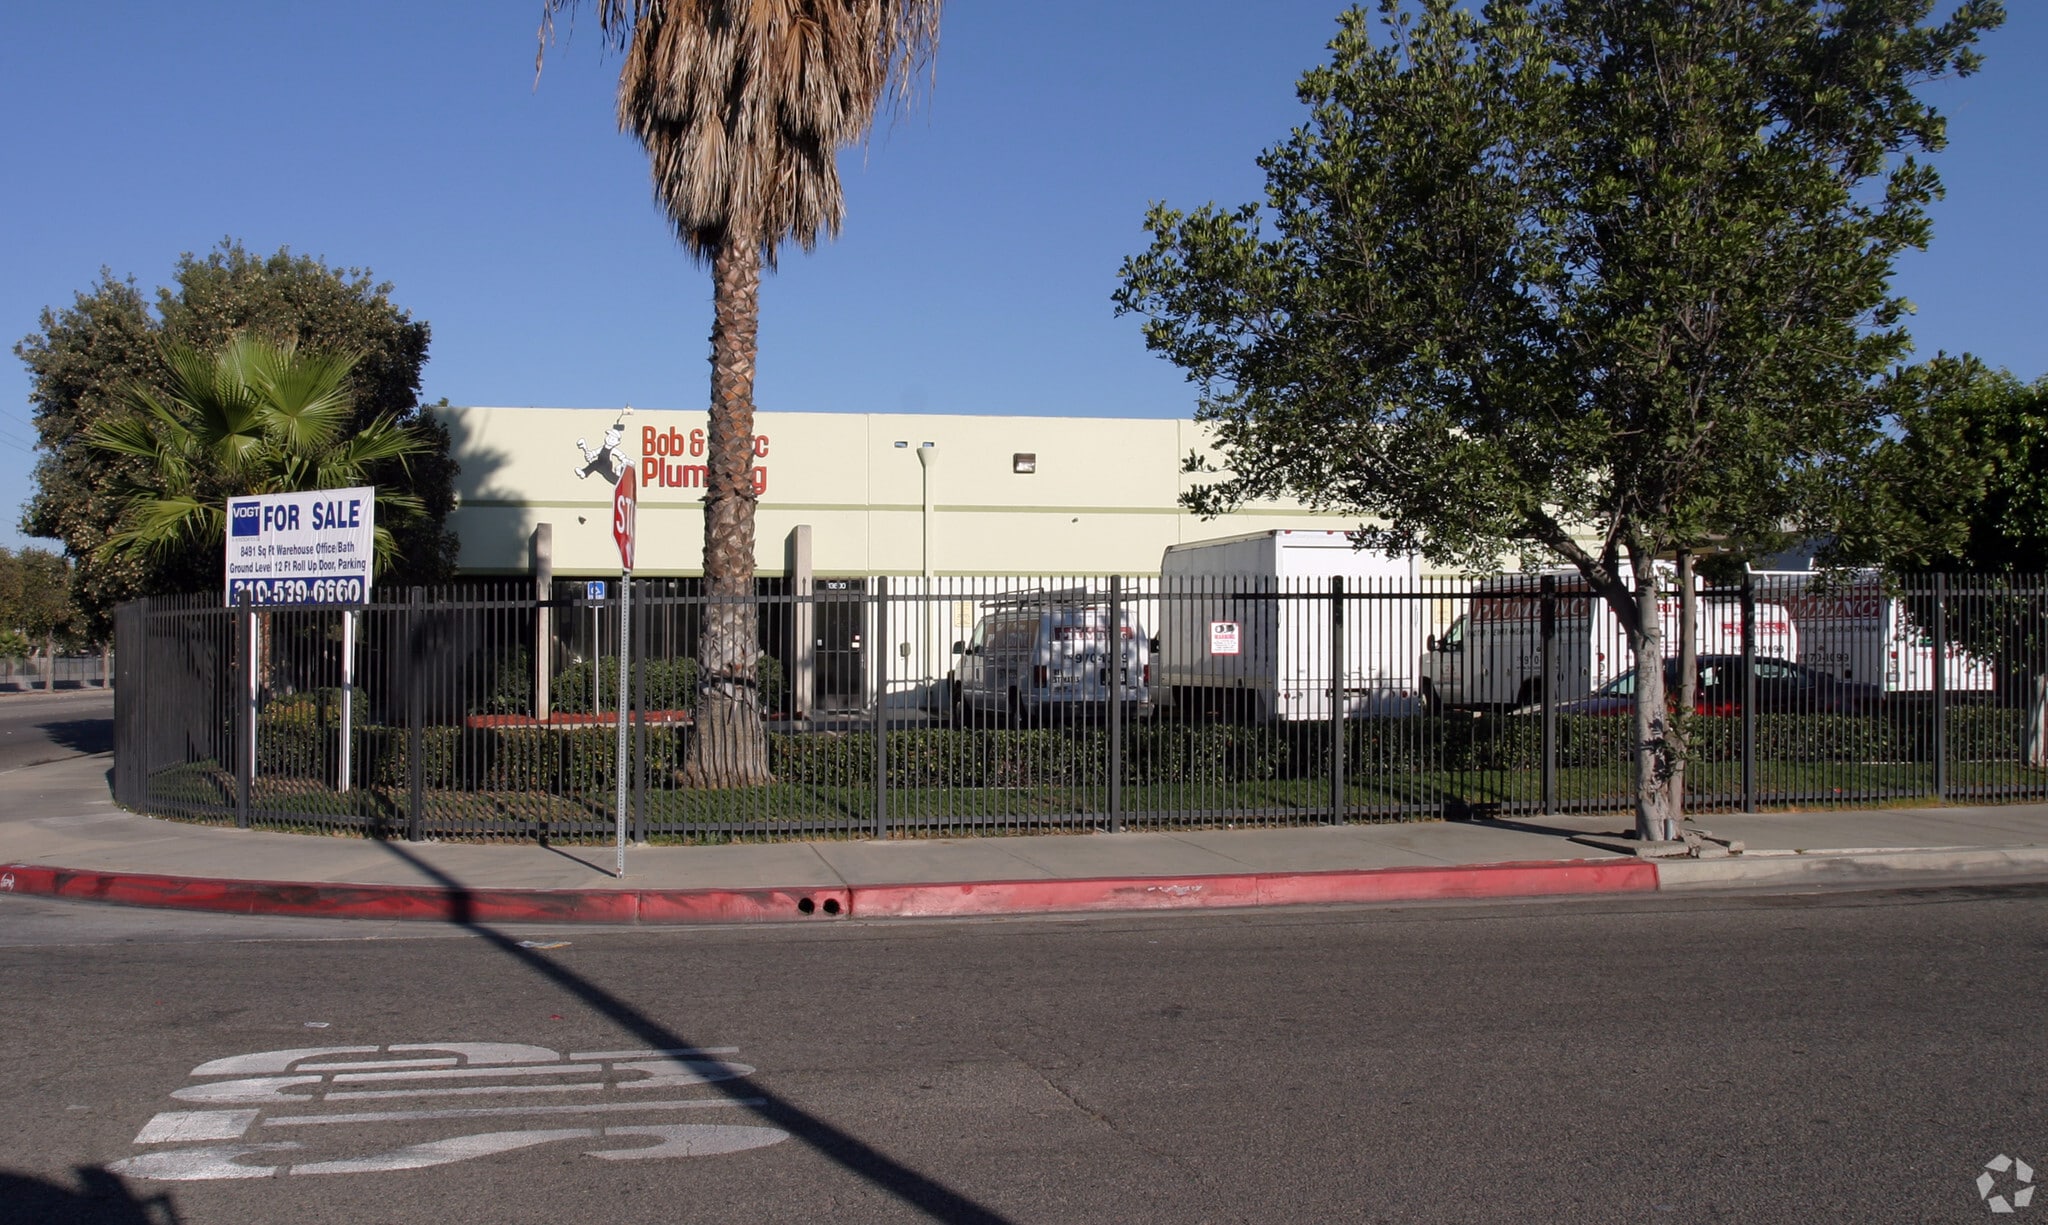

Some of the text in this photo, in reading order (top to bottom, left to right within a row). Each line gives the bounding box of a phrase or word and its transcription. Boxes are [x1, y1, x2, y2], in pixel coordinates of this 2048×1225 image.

[642, 426, 705, 457] Bob &
[642, 457, 767, 495] Plumg
[232, 506, 260, 518] VOGT
[264, 500, 361, 531] FOR SALE
[230, 557, 366, 574] Ground Level 12 Ft Roll Up Door, Parking
[240, 546, 256, 557] 8491
[258, 545, 267, 559] Sq
[268, 544, 275, 556] Ft
[277, 543, 314, 556] Warehouse
[107, 1043, 790, 1180] STOP
